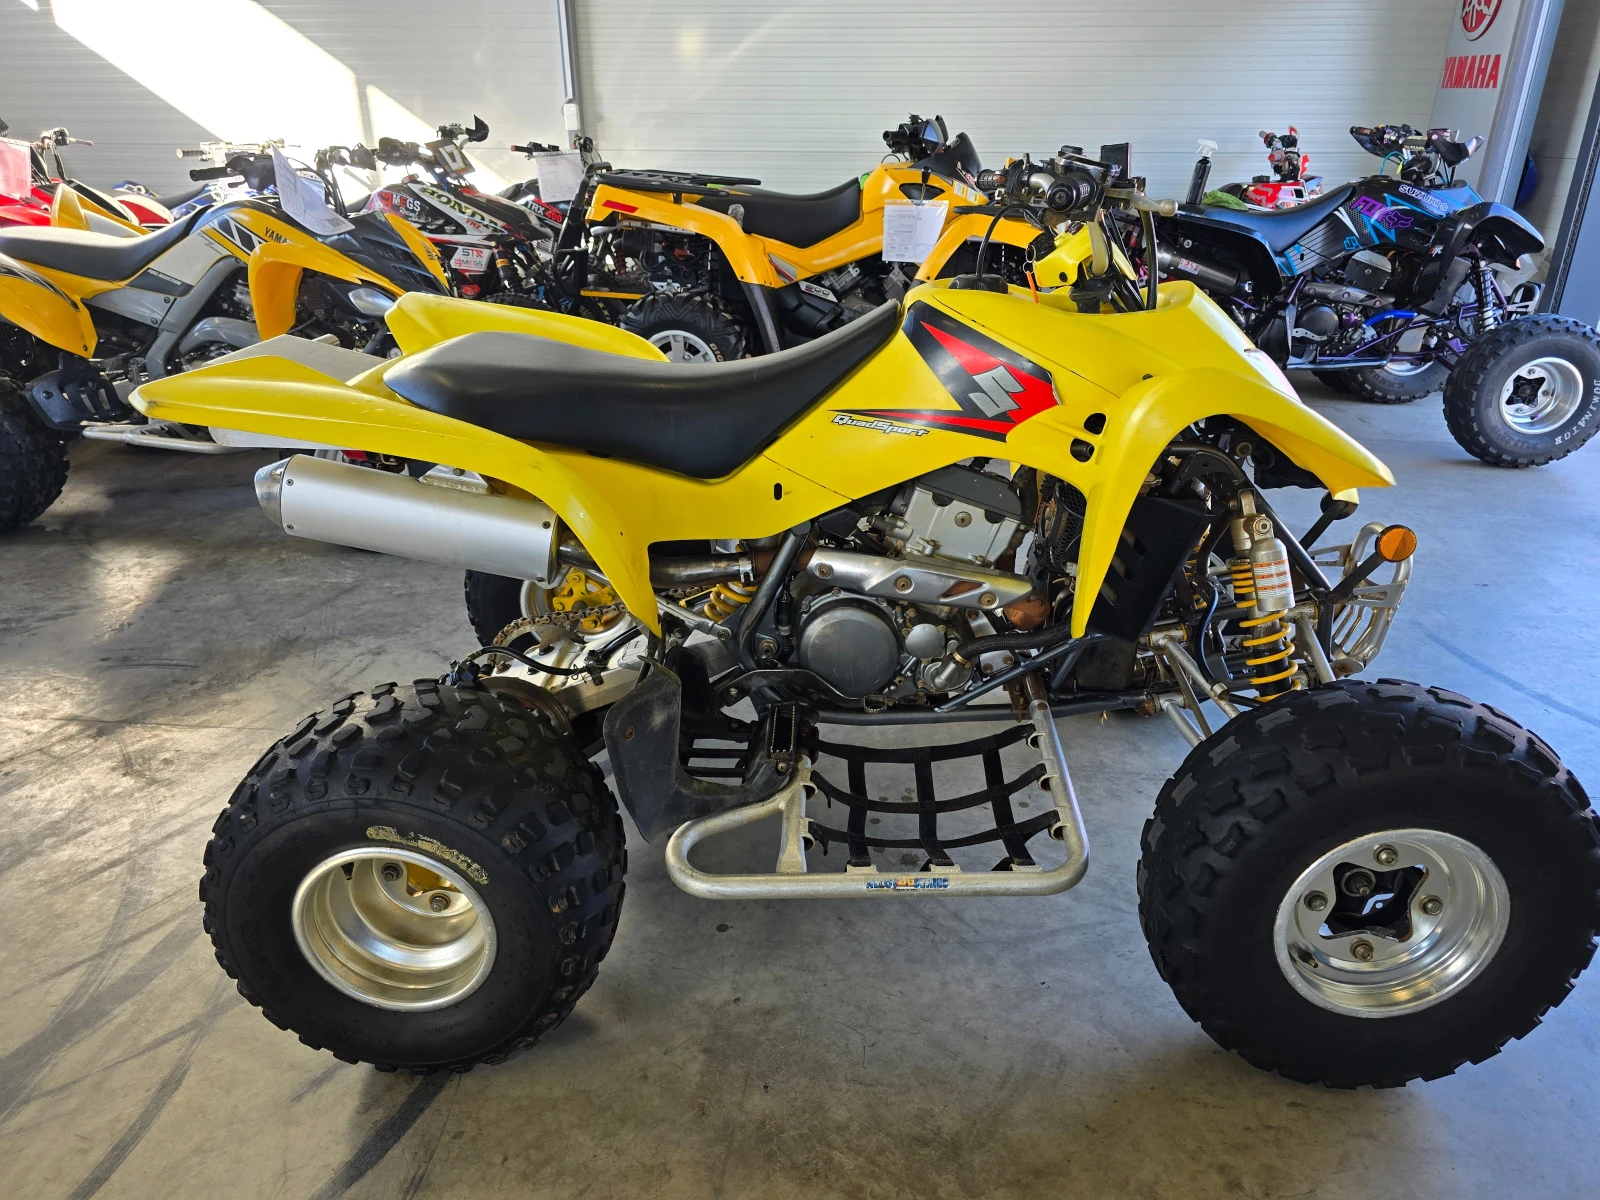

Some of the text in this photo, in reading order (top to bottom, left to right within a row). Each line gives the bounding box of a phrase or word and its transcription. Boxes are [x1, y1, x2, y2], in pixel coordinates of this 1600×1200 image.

[1441, 54, 1501, 88] YAMAHA
[1399, 184, 1440, 208] SUZUKI
[419, 186, 502, 235] HONDA
[527, 200, 563, 223] TRX 400
[264, 226, 288, 244] YAMA
[465, 218, 482, 230] TRX
[831, 413, 930, 437] QuadSport
